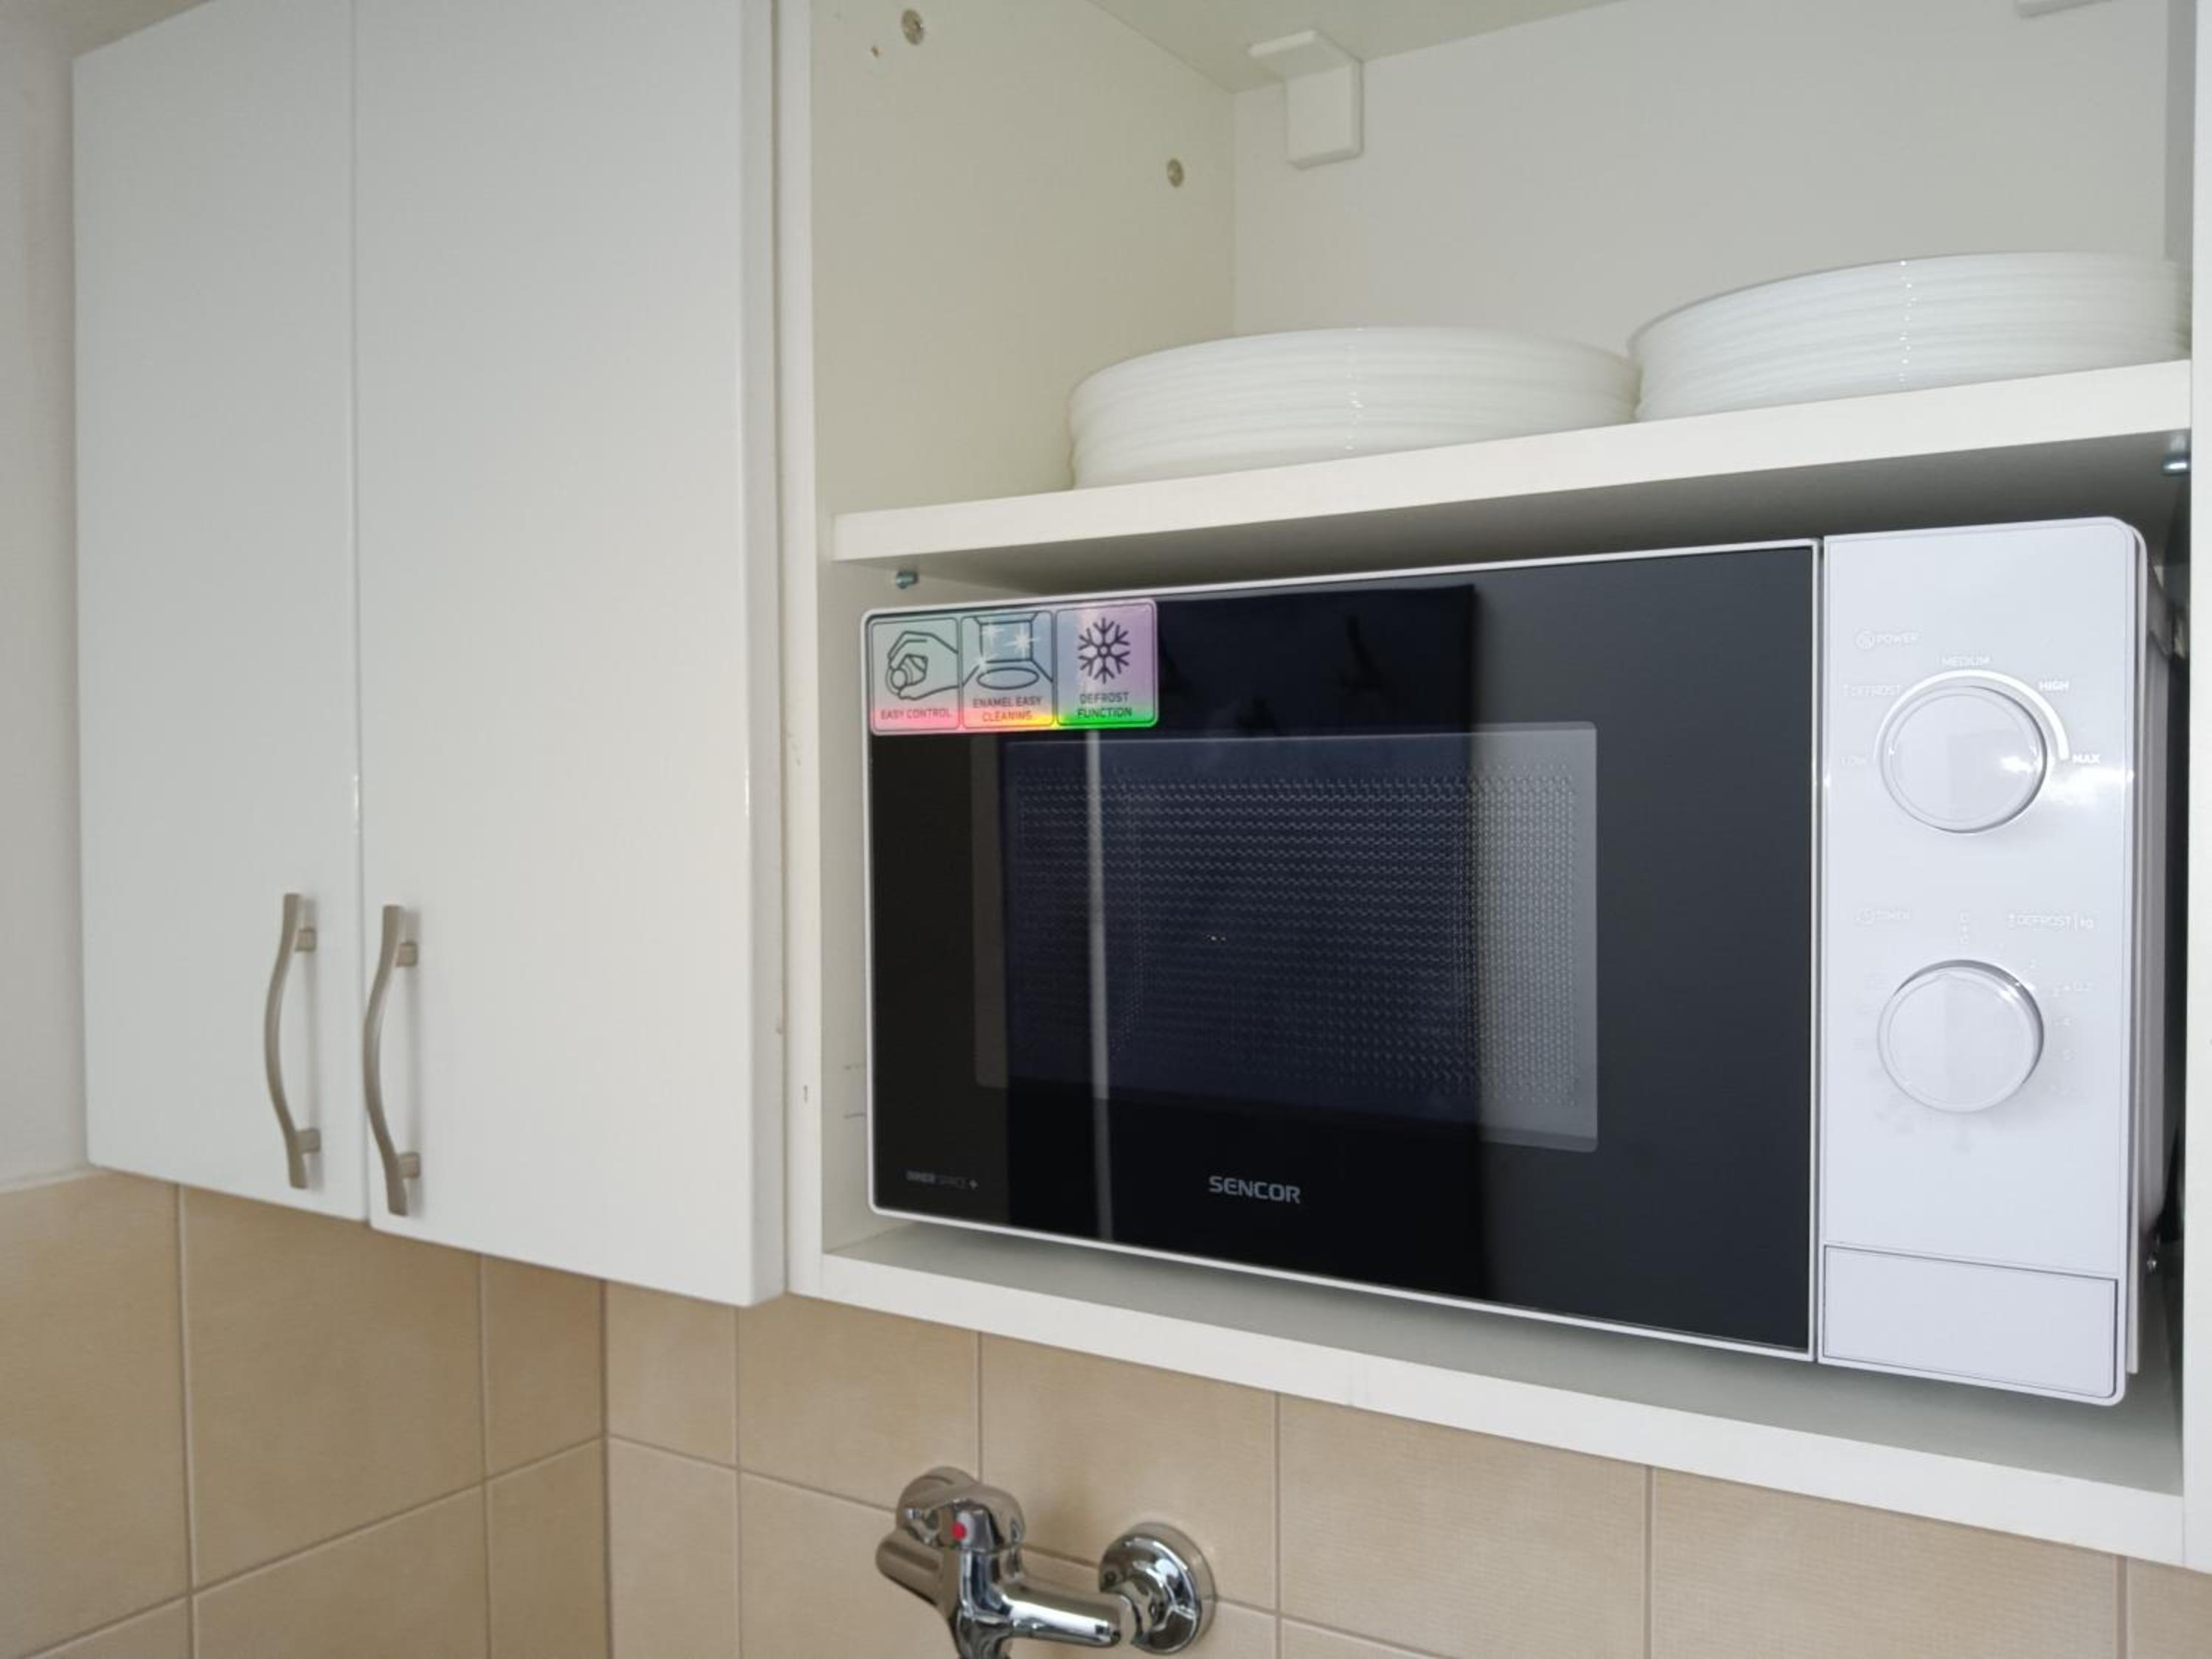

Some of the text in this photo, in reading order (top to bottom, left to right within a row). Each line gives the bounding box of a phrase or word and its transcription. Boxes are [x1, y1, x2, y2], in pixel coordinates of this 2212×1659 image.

[2039, 679, 2070, 691] HIGH
[973, 695, 1043, 709] ENAMEL EASY
[1079, 691, 1130, 704] DEFROST
[880, 707, 953, 720] EASY CONTROL
[981, 710, 1033, 722] CLEANING
[1077, 706, 1133, 720] FUNCTION
[2072, 753, 2101, 765] MAX
[1209, 1175, 1301, 1204] SENCOR
